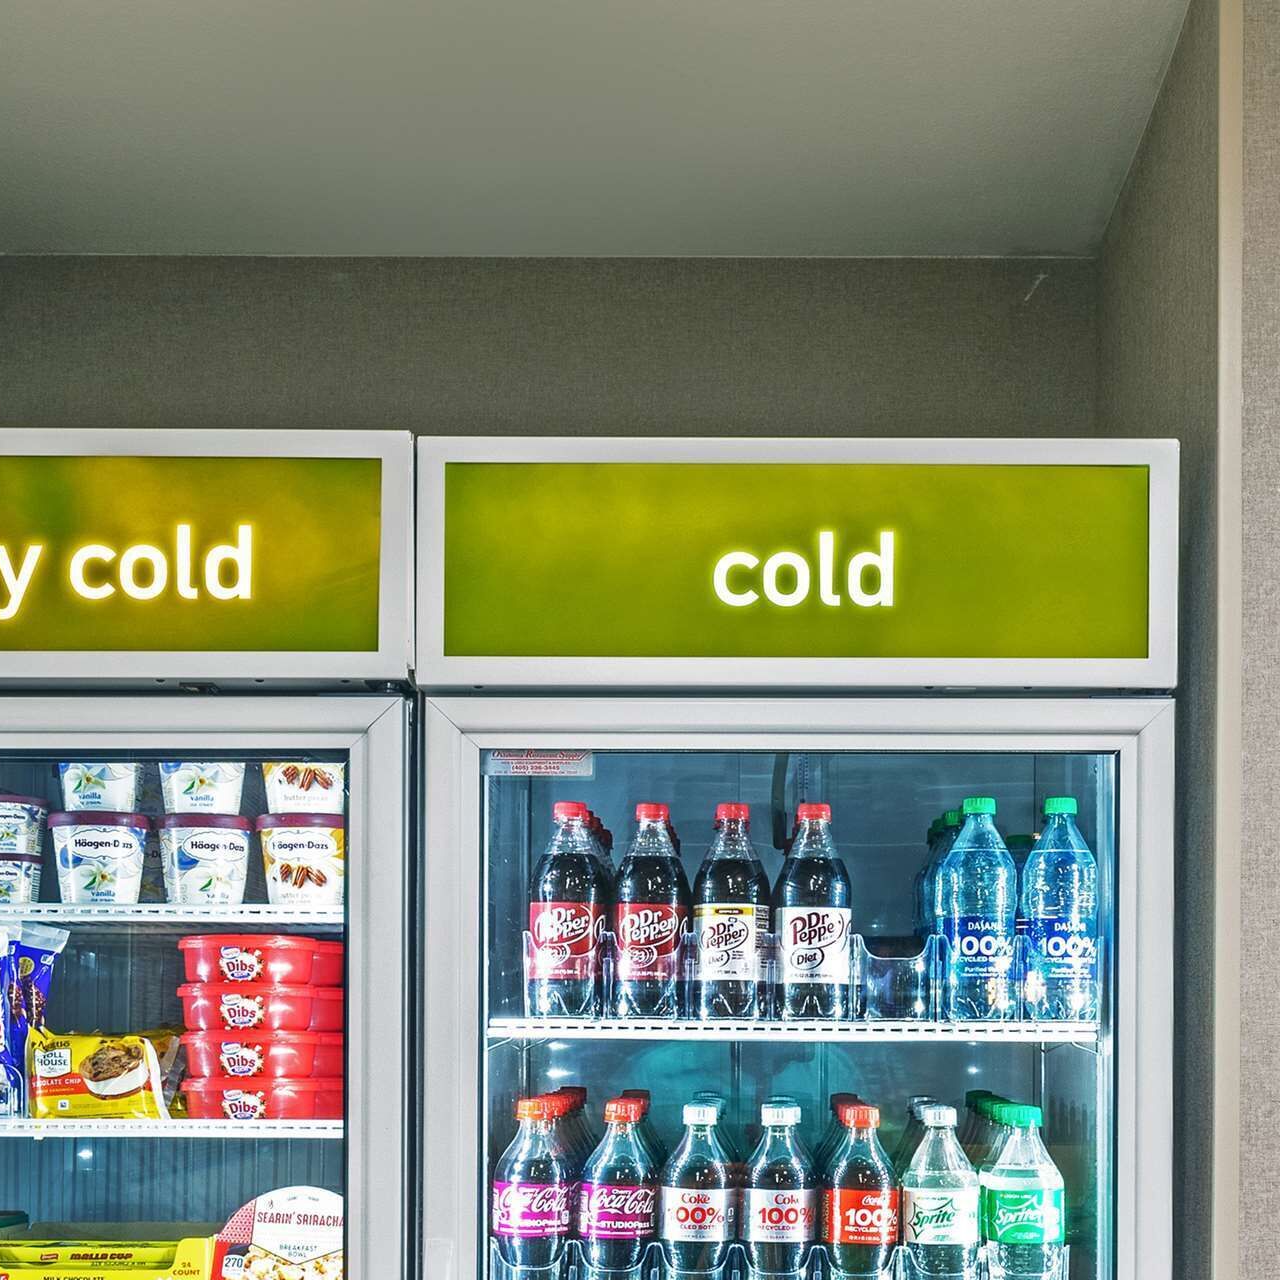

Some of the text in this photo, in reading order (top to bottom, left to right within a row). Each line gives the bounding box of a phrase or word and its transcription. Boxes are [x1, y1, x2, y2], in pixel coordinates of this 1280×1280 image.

[69, 525, 254, 602] cold
[714, 531, 896, 608] cold
[640, 908, 660, 924] Dr
[807, 911, 830, 927] Dr
[627, 914, 676, 946] Pepper
[715, 919, 733, 932] Dr
[957, 935, 1014, 956] 100%
[226, 958, 255, 973] Dibs
[796, 952, 819, 964] Diet
[228, 1005, 257, 1020] Dibs
[227, 1053, 255, 1068] Dibs
[229, 1100, 258, 1115] Dibs
[844, 1208, 898, 1226] 100%
[912, 1206, 956, 1227] Sprite
[224, 1257, 243, 1268] 270
